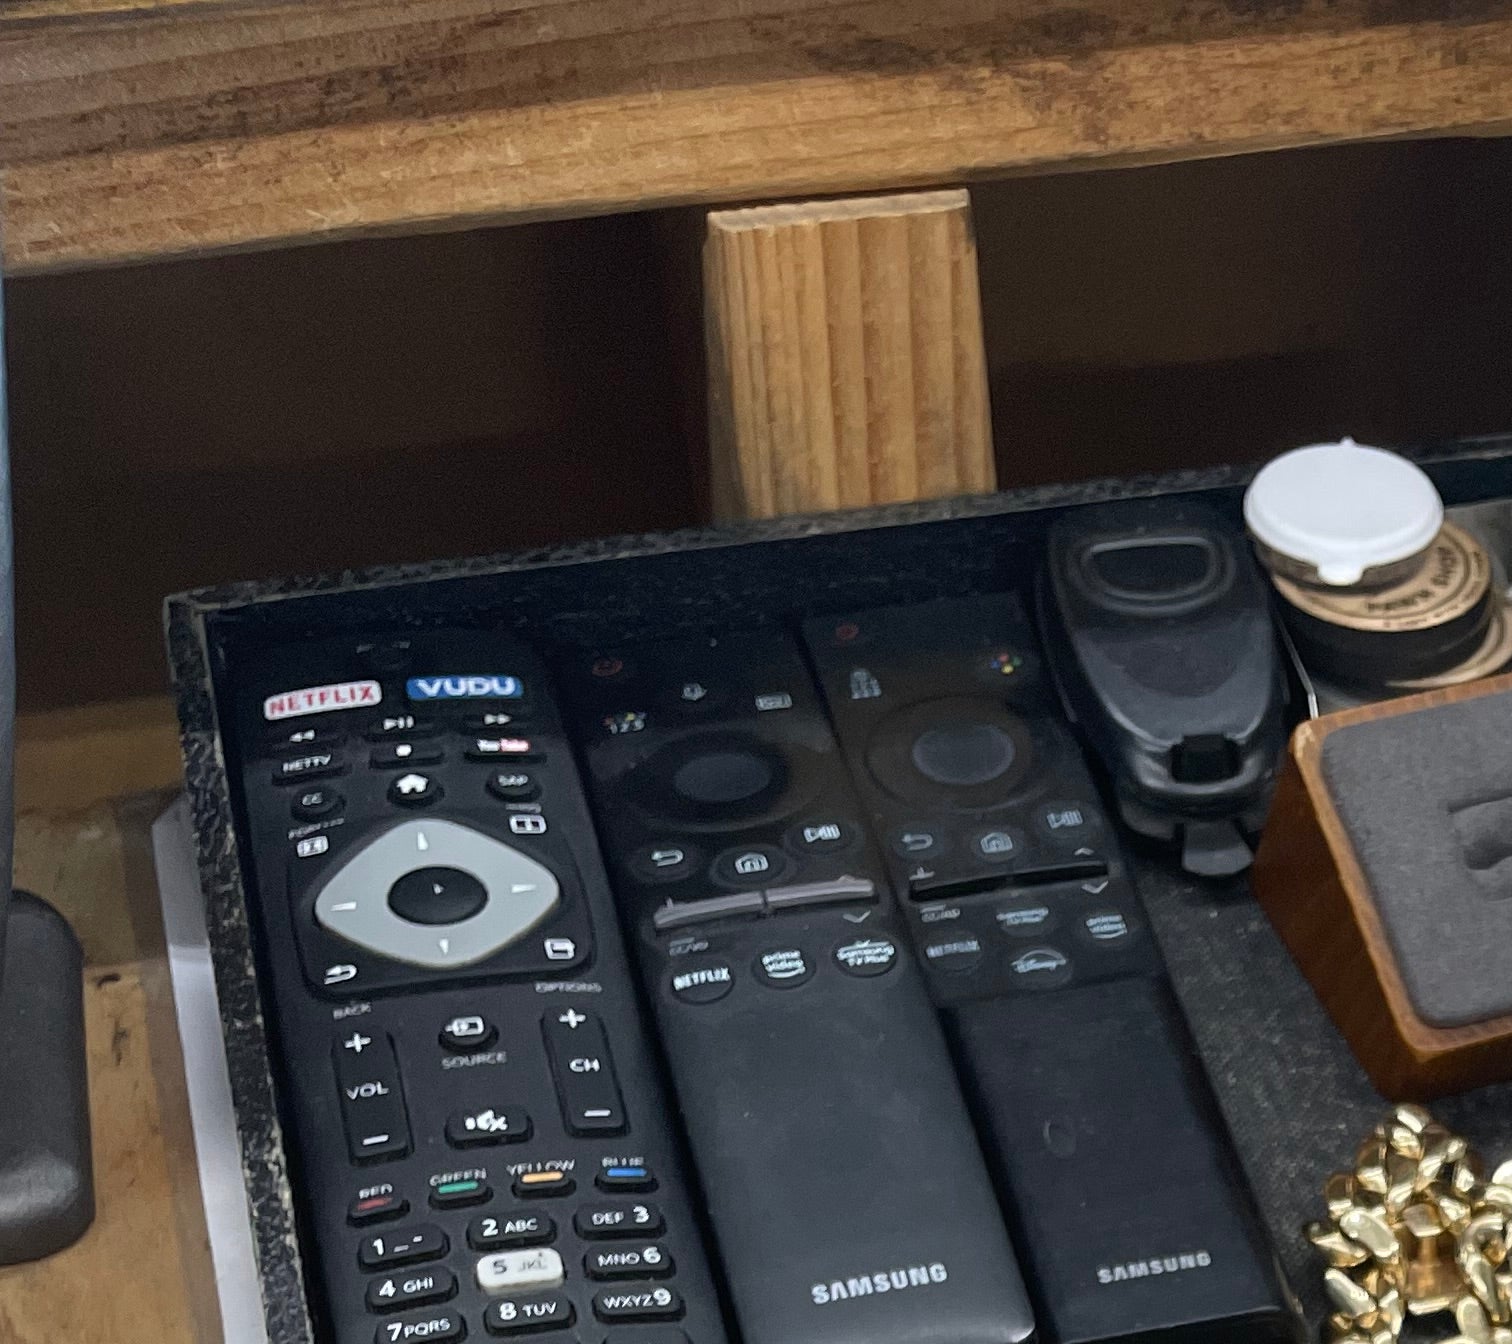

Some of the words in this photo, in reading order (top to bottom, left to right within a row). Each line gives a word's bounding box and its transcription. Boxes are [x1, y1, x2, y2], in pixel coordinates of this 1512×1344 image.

[417, 676, 516, 698] VUDU
[268, 684, 376, 717] NETFLIX
[535, 981, 602, 994] OPTIONS
[672, 966, 731, 991] NETFLIX
[332, 1001, 373, 1020] BACK
[441, 1051, 508, 1071] SOURCE
[568, 1057, 601, 1073] CH
[346, 1081, 390, 1100] VOL
[428, 1167, 488, 1187] GREEN
[506, 1158, 576, 1177] YELLOW
[591, 1210, 625, 1226] DEF
[632, 1204, 650, 1223] 3
[481, 1217, 499, 1237] 2
[505, 1217, 539, 1234] ABC
[372, 1237, 385, 1257] 1
[597, 1252, 640, 1268] MNO
[642, 1246, 661, 1264] 6
[492, 1260, 508, 1274] 5
[1096, 1249, 1212, 1284] SAMSUNG
[378, 1279, 397, 1298] 4
[403, 1277, 434, 1294] GHI
[810, 1262, 949, 1305] SAMSUNG
[603, 1293, 653, 1310] WXYZ
[653, 1287, 672, 1306] 9
[499, 1302, 518, 1320] 8
[522, 1301, 557, 1317] TUV
[386, 1321, 403, 1341] 7
[403, 1317, 451, 1337] PQRS
